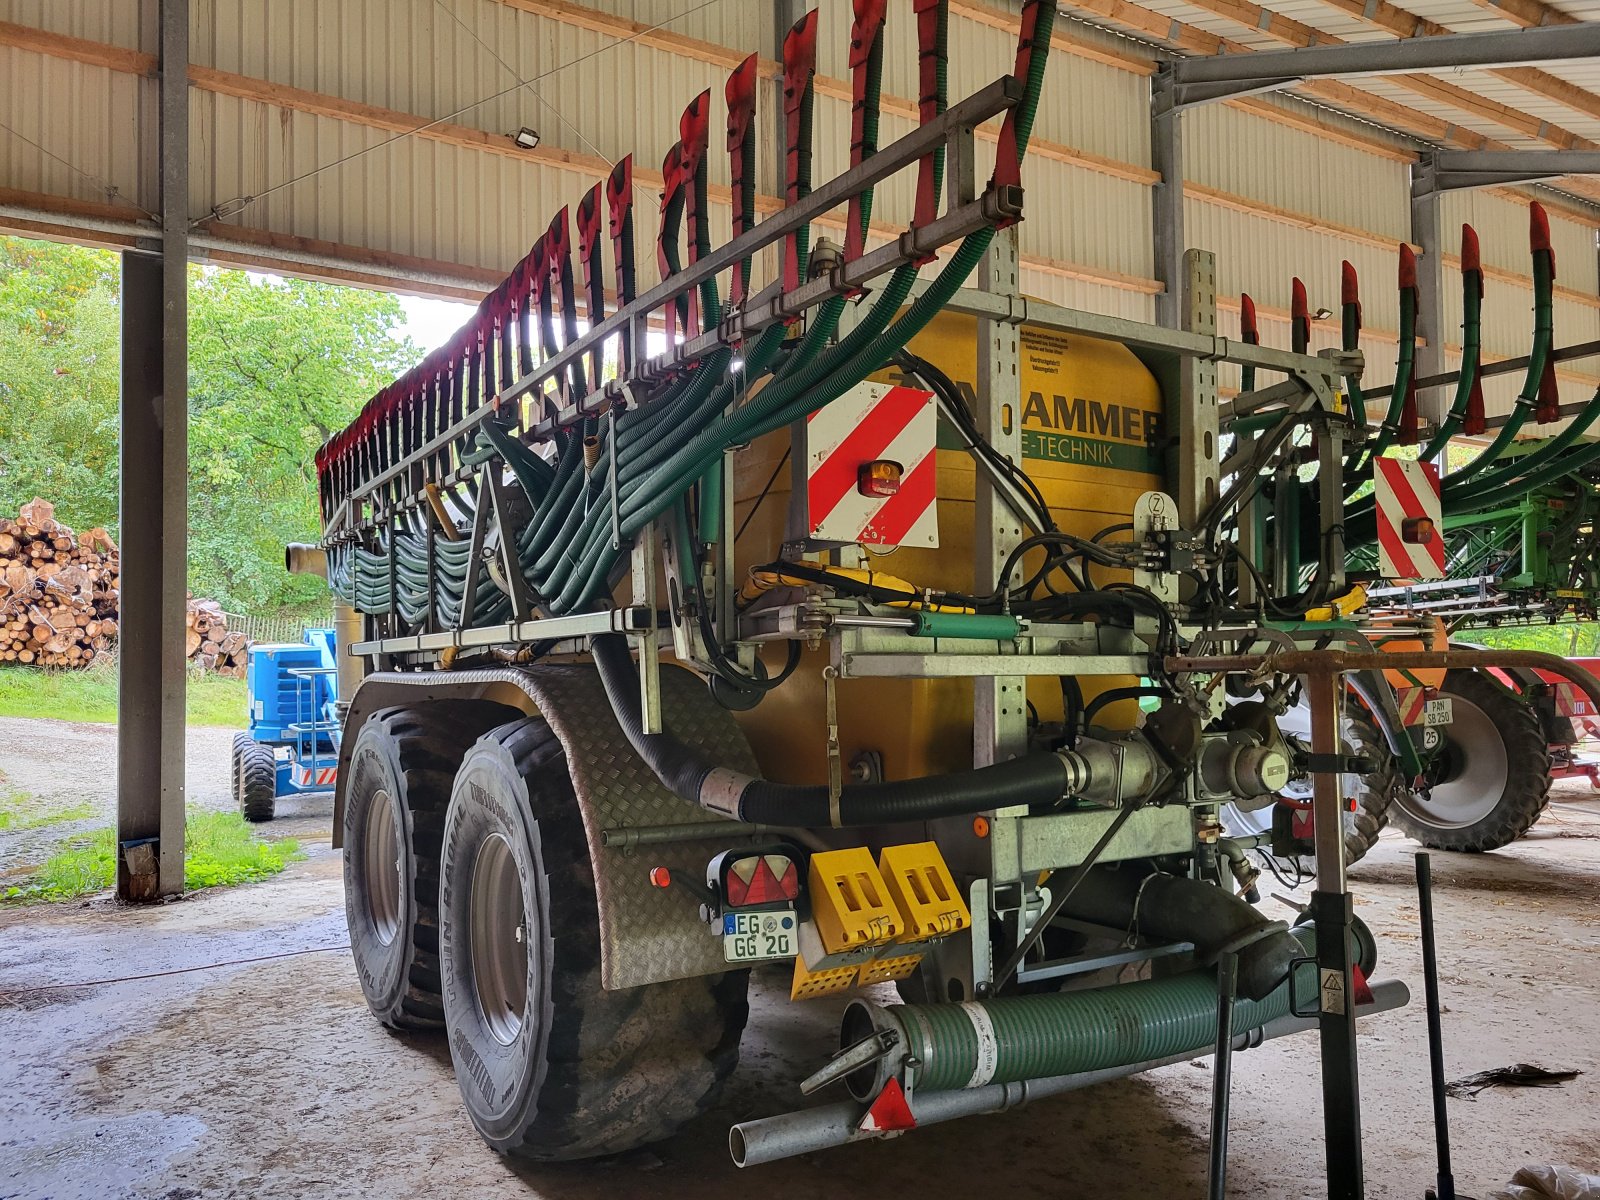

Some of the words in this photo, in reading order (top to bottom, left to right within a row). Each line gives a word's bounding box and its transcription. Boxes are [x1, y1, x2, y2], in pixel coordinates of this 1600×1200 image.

[1432, 700, 1445, 712] PAN
[1427, 713, 1436, 724] SB
[1437, 711, 1450, 723] 250
[1426, 731, 1436, 744] 25
[443, 802, 467, 908] RADIAL
[737, 915, 760, 934] EG
[734, 937, 757, 957] GG
[765, 934, 789, 955] 20
